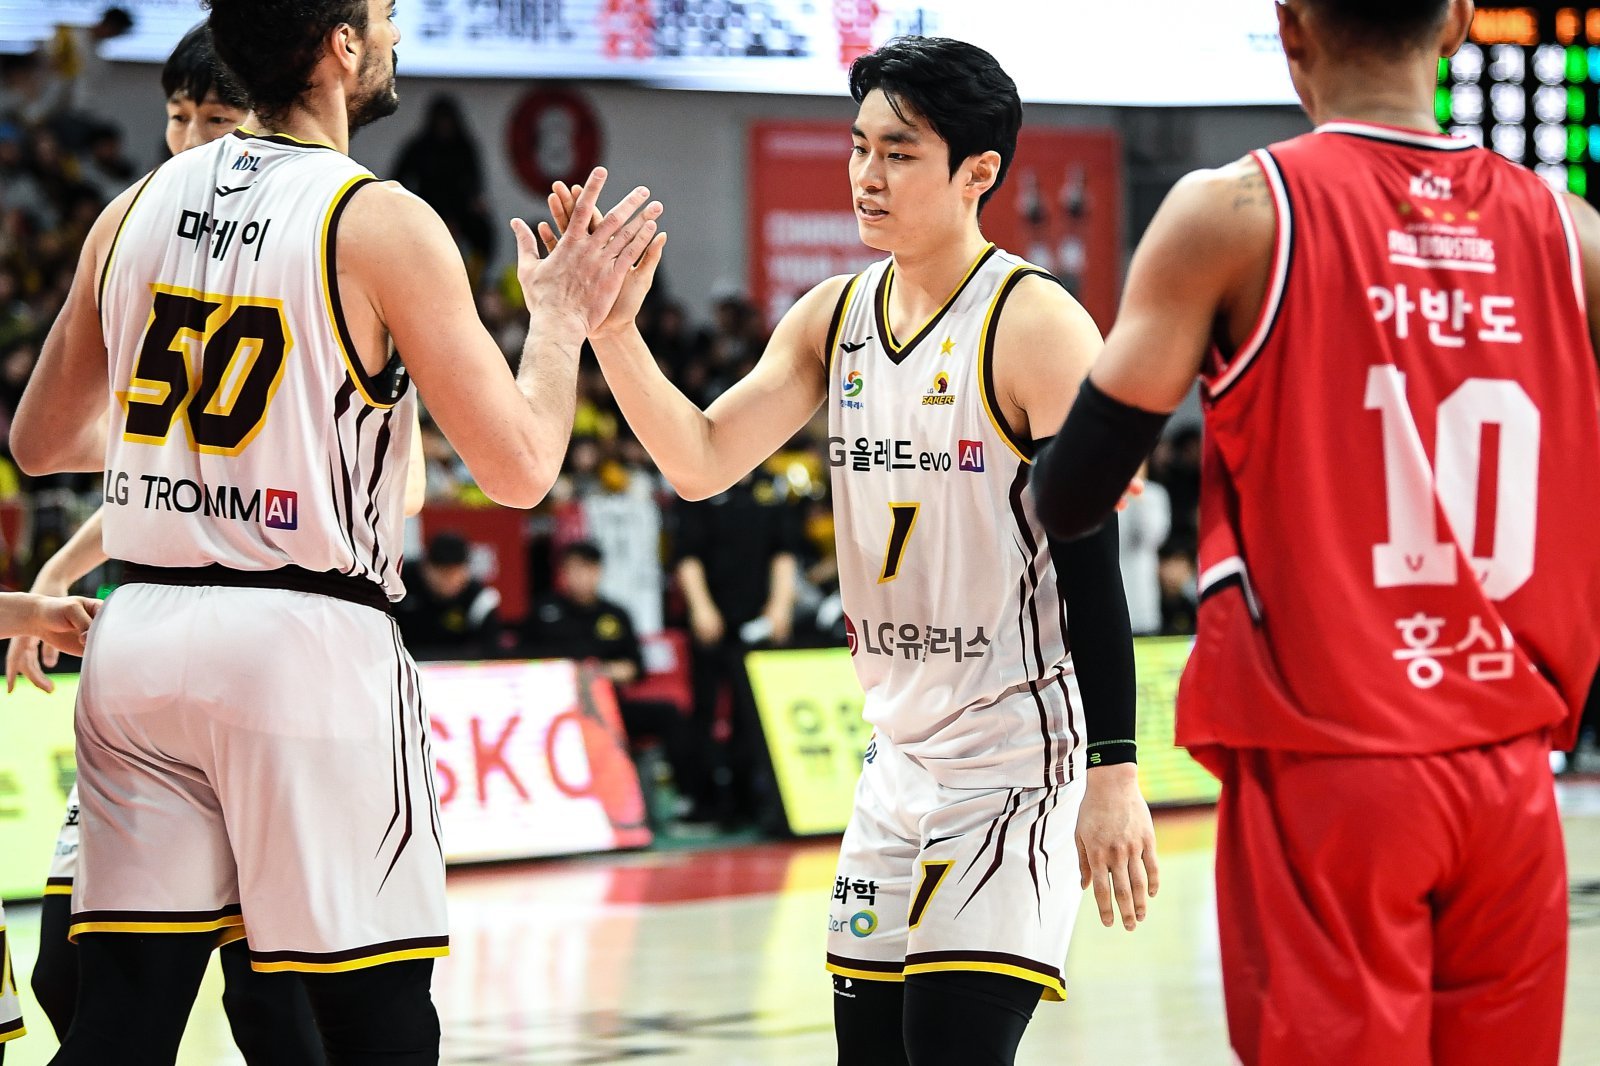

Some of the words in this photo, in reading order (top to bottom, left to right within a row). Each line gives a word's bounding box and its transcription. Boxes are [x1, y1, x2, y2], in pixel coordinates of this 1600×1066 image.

[115, 282, 295, 458] 50
[850, 437, 917, 473] 올레드
[919, 451, 951, 472] evo
[961, 445, 982, 469] AI
[1363, 363, 1541, 602] 10
[105, 469, 129, 506] LG
[140, 474, 261, 523] TROMM
[266, 496, 293, 524] AI
[831, 875, 880, 906] 화학
